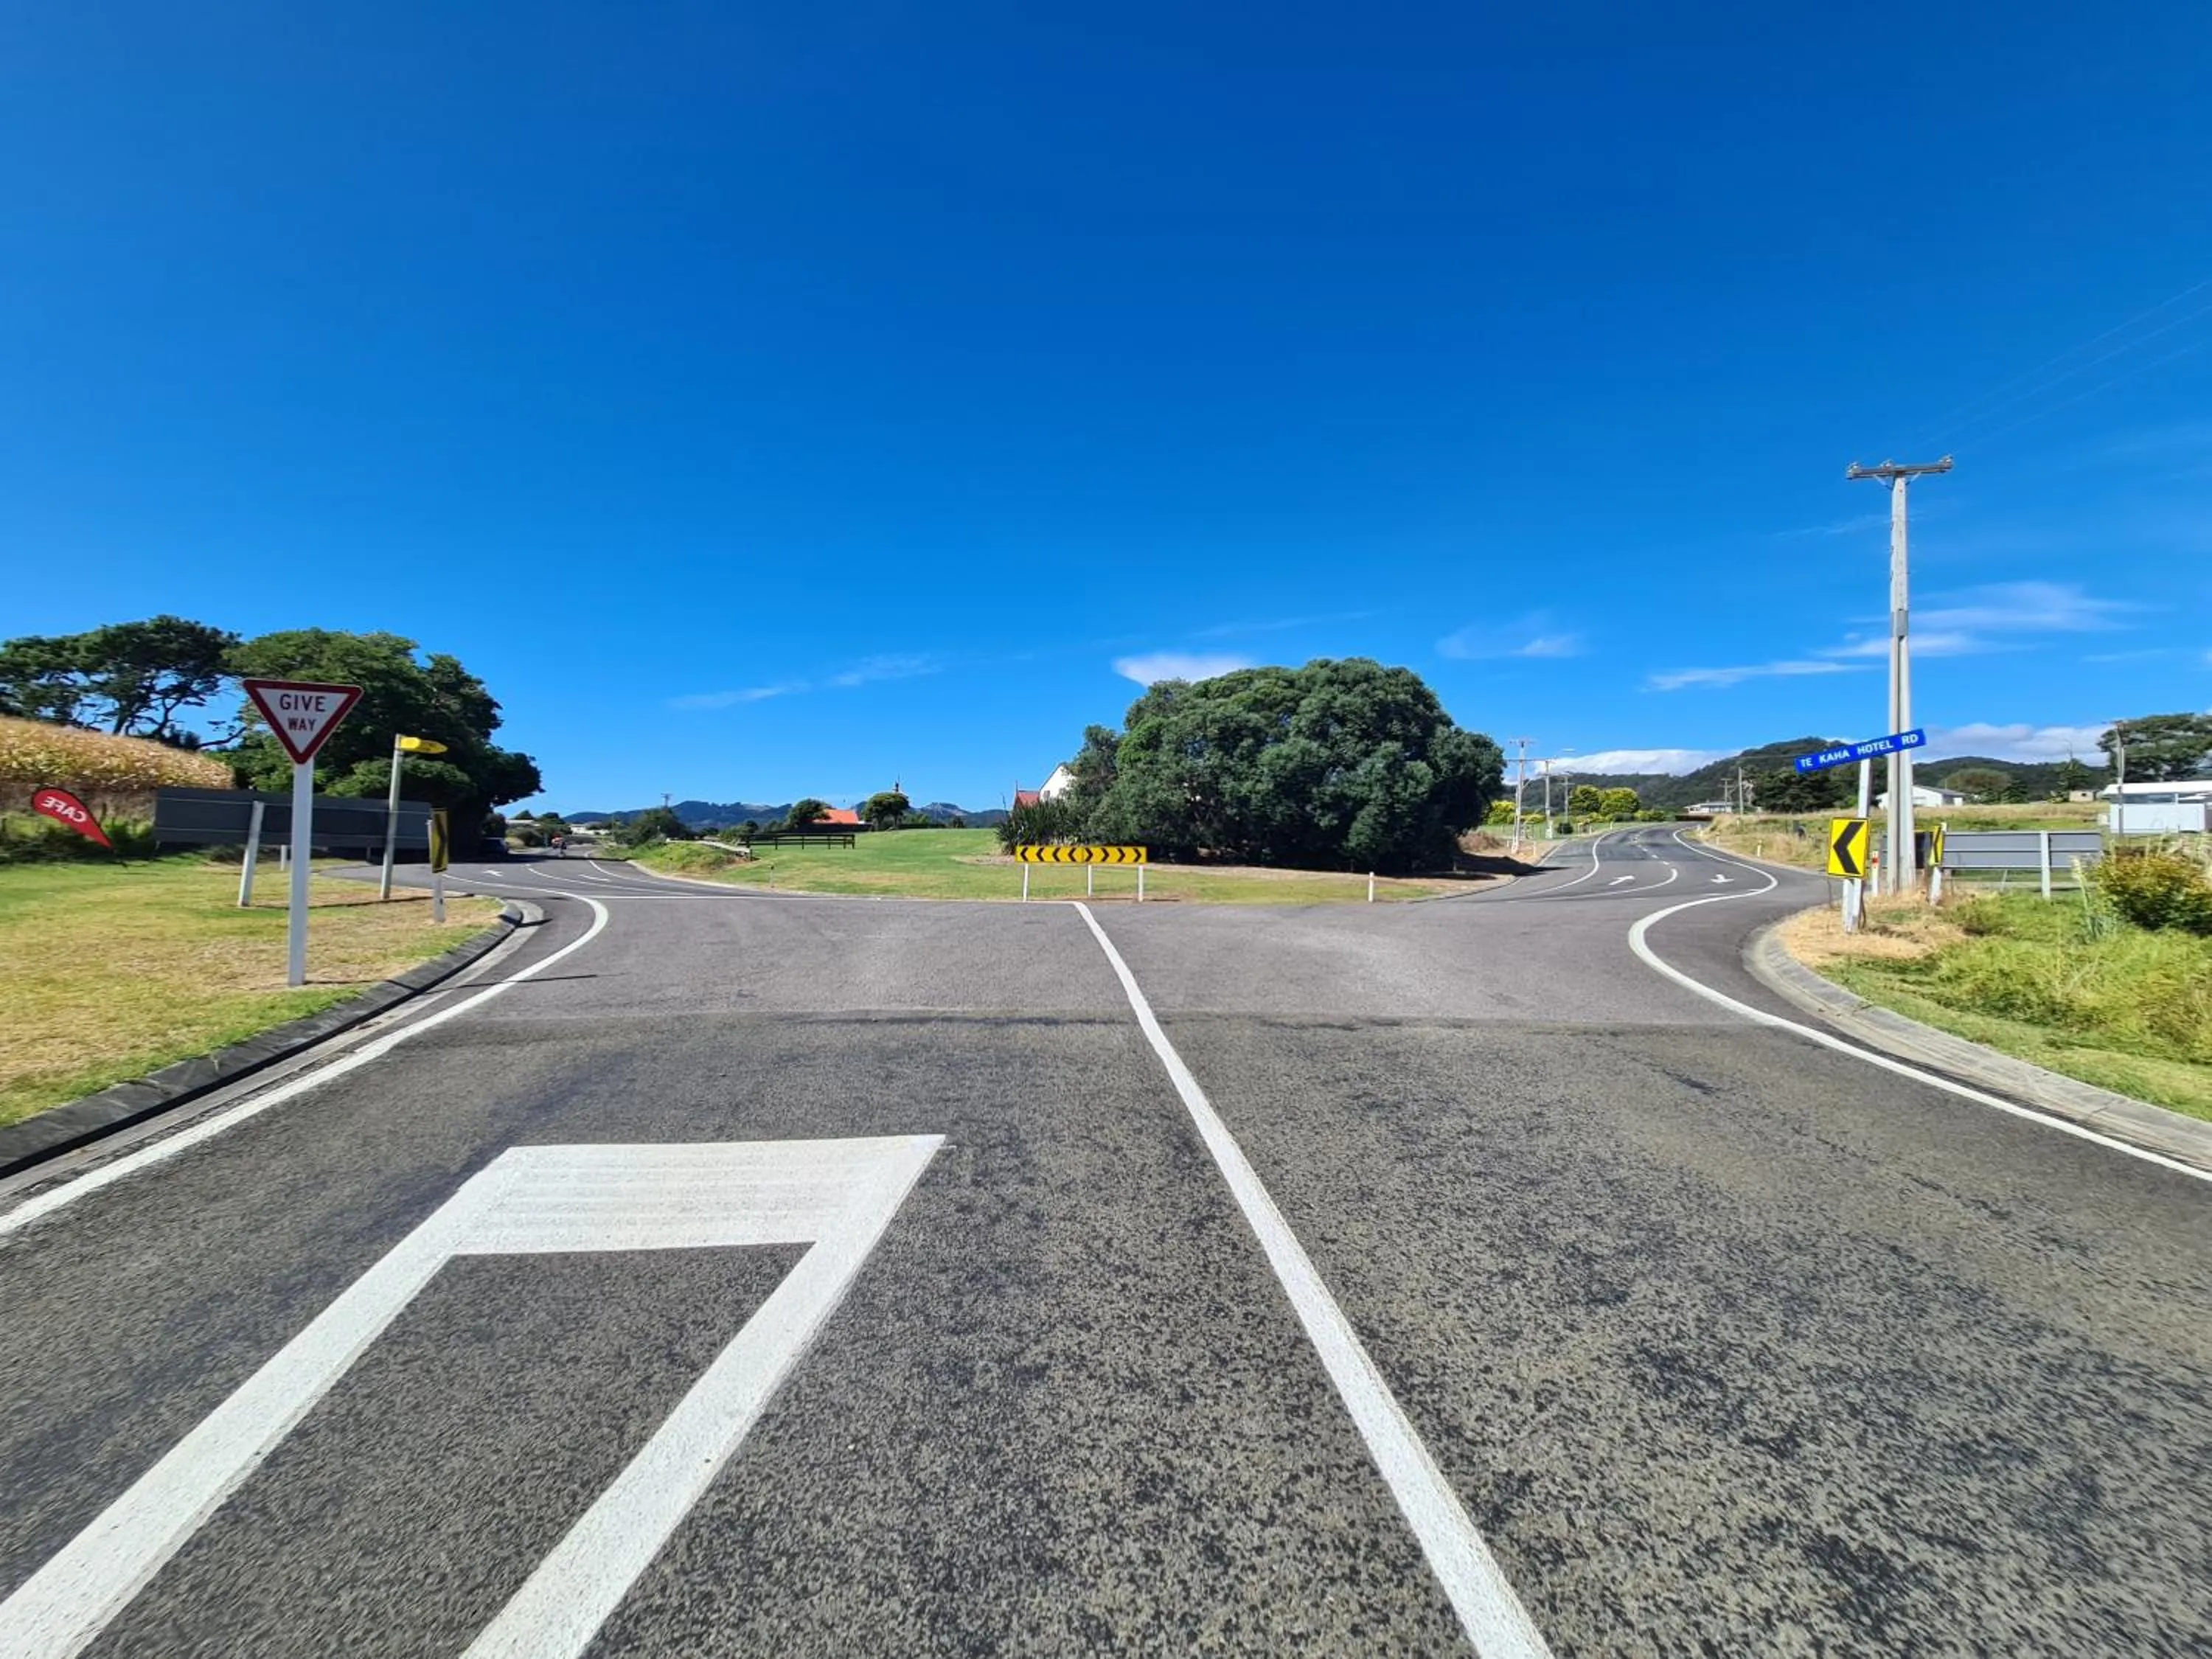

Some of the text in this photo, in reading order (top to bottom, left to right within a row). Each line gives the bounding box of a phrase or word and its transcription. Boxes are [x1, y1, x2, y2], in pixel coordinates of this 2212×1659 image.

[279, 694, 326, 712] GIVE
[288, 717, 316, 731] WAY
[1800, 734, 1919, 768] TE KAHA HOTEL RD
